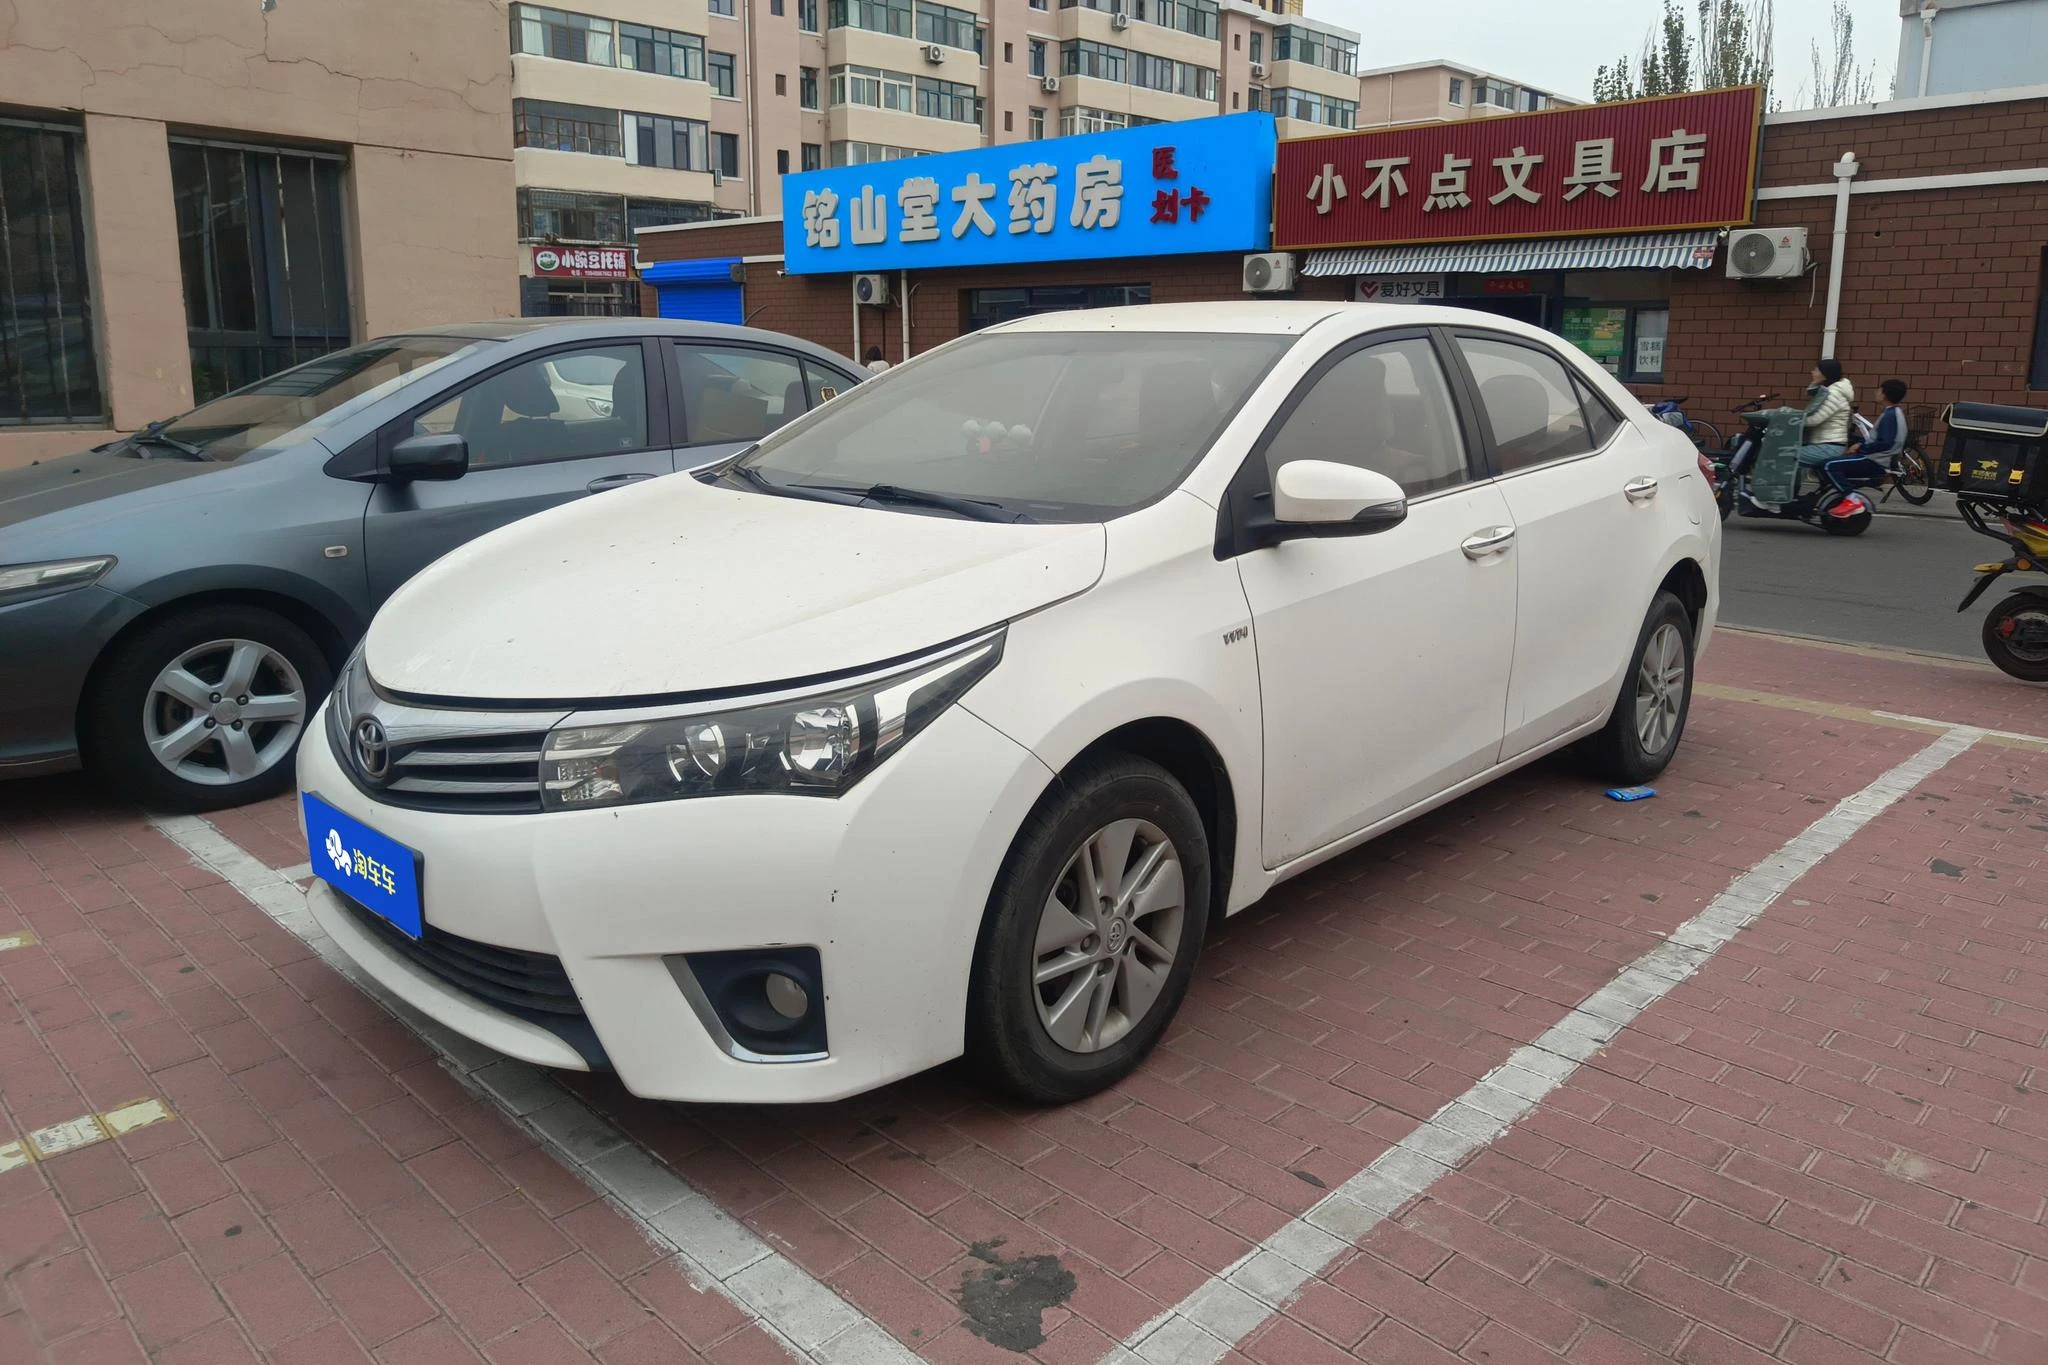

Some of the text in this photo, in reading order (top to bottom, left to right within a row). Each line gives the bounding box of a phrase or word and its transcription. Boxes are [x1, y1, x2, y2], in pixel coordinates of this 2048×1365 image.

[1152, 146, 1178, 180] 医
[1306, 128, 1708, 214] 小不点文具店
[802, 154, 1124, 248] 铭山堂大药房
[1150, 186, 1210, 224] 划卡
[1380, 280, 1440, 298] 爱好文具
